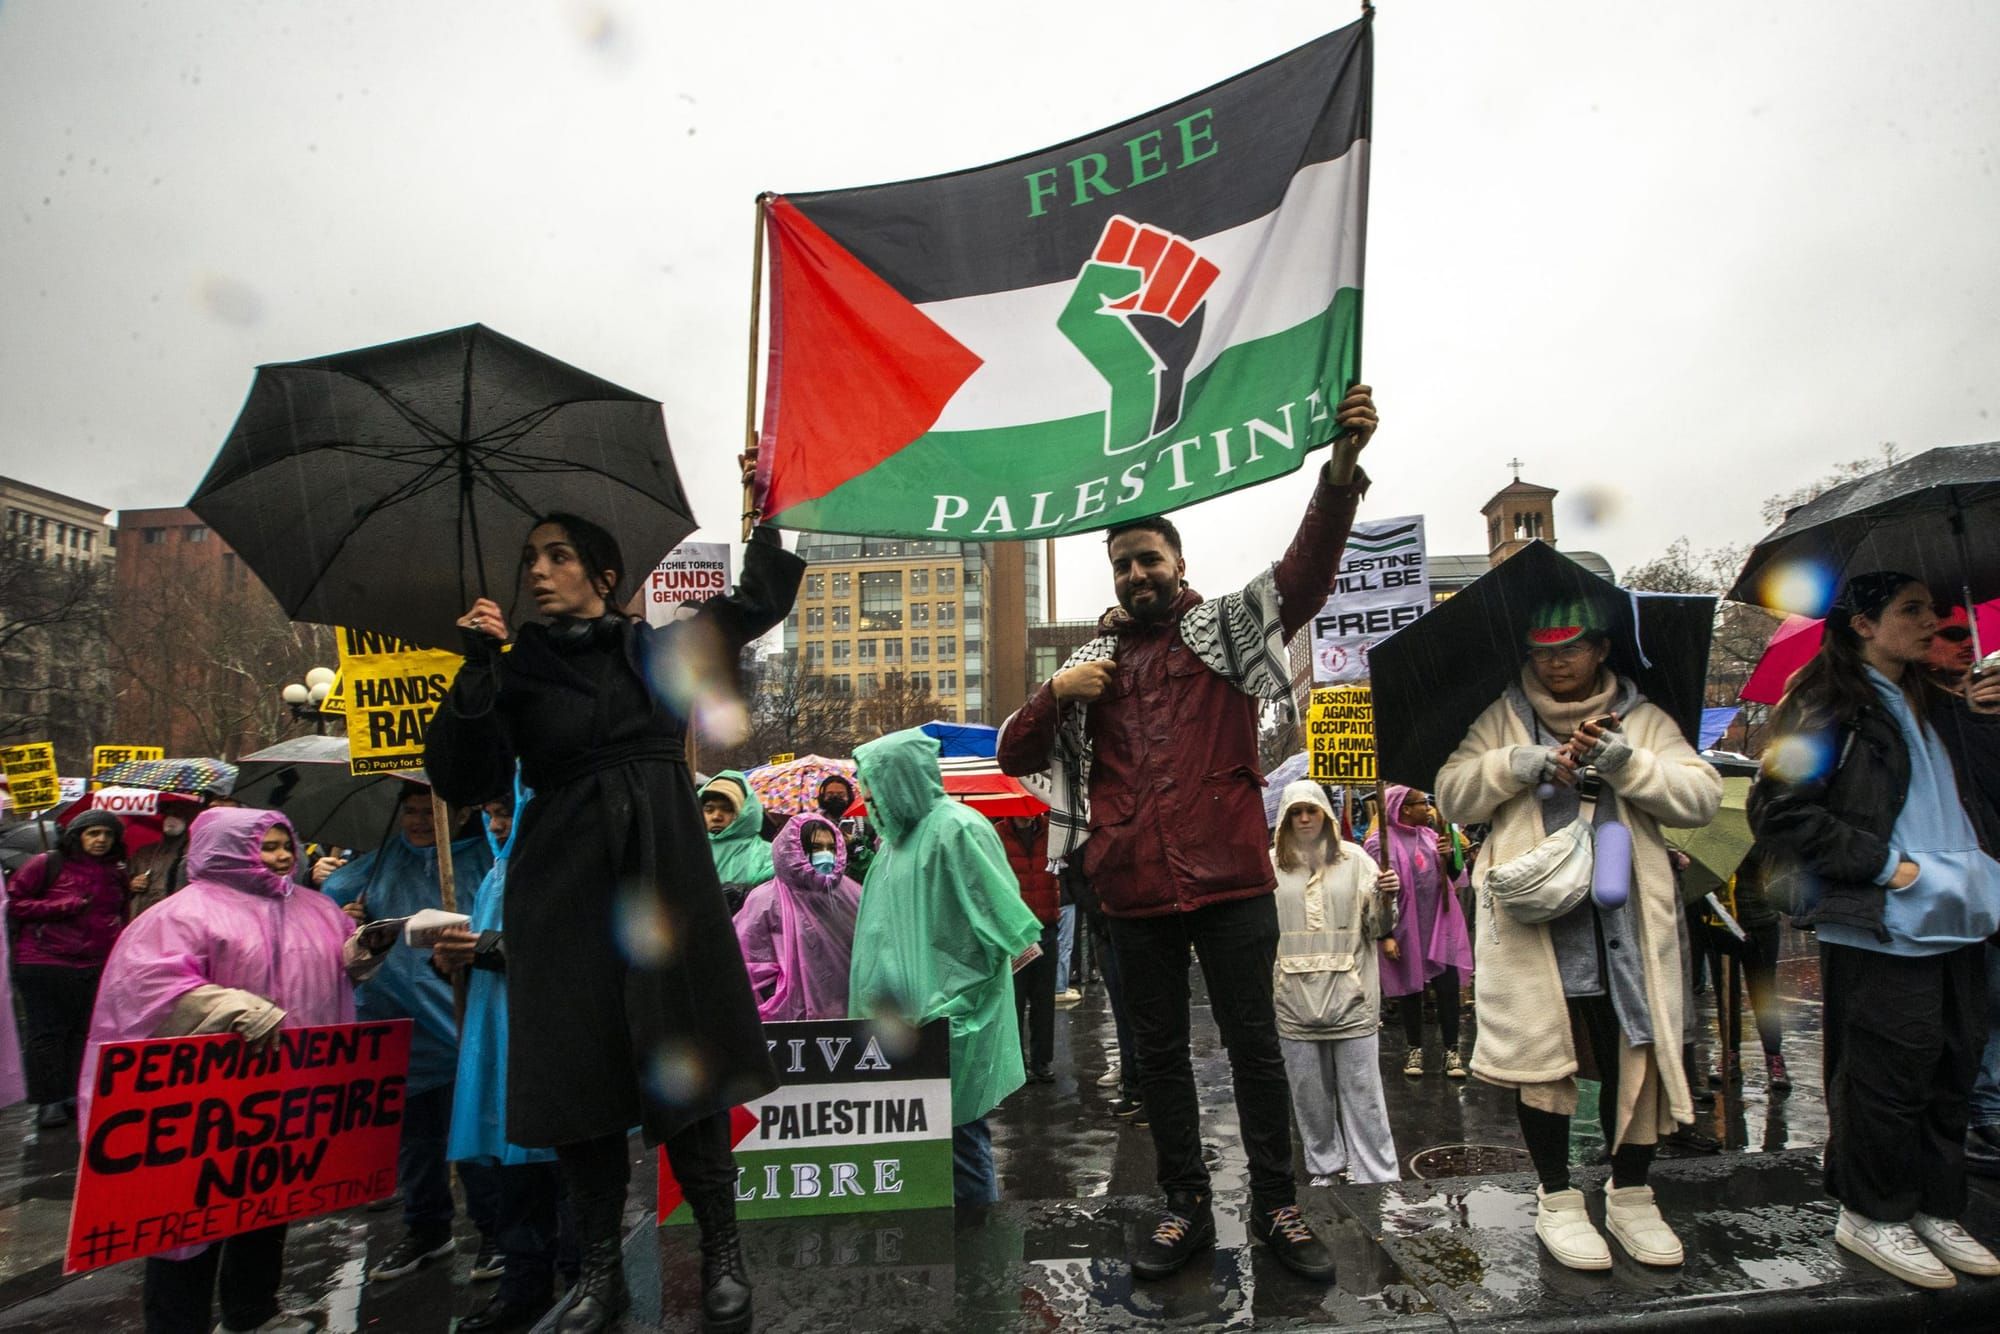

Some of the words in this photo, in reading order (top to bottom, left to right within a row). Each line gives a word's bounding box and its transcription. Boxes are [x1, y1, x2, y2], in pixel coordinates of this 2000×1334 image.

[1023, 107, 1221, 219] FREE
[688, 561, 724, 569] TORRES
[652, 570, 725, 589] FUNDS
[1333, 575, 1378, 594] ILL
[1382, 568, 1422, 588] BE
[653, 590, 725, 603] GENOCID
[354, 673, 448, 708] HANDS
[1323, 705, 1373, 720] AGAINST
[97, 749, 132, 764] FREE
[1313, 737, 1325, 751] IS
[1328, 737, 1336, 751] A
[373, 760, 399, 769] Party
[400, 758, 414, 767] for
[1313, 751, 1375, 777] RIGHT
[95, 793, 156, 812] NOW!
[99, 1024, 394, 1097] PERMANENT
[88, 1076, 407, 1175] CEASEFIRE
[759, 1097, 929, 1141] PALESTINA
[194, 1139, 329, 1208] NOW
[734, 1158, 905, 1202] LIBRE
[236, 1168, 395, 1228] PALESTINE
